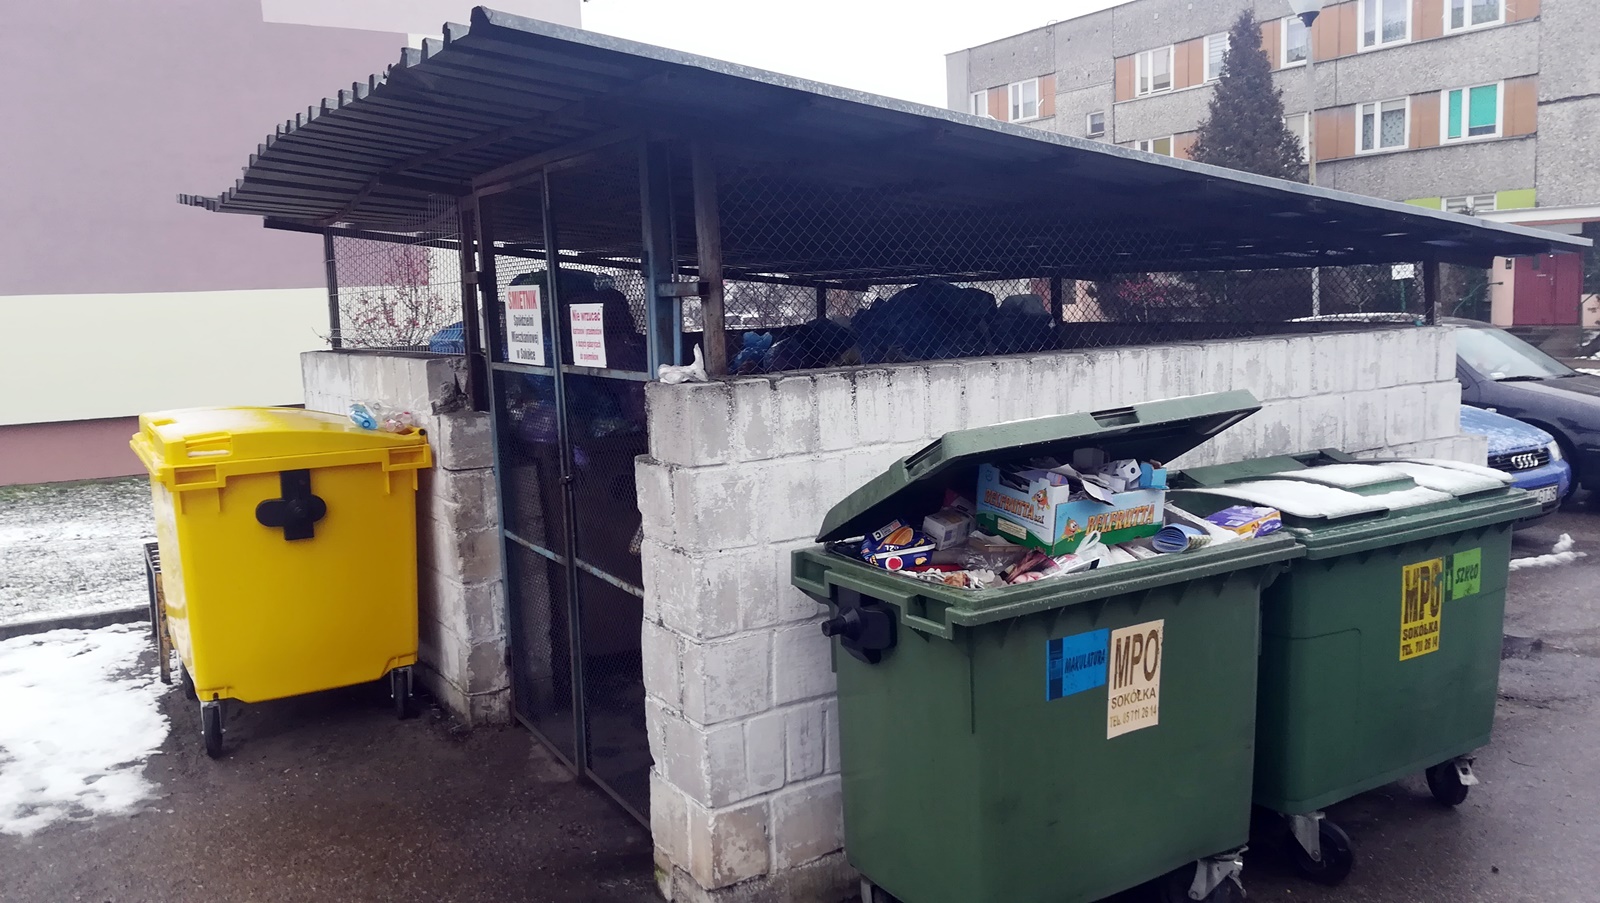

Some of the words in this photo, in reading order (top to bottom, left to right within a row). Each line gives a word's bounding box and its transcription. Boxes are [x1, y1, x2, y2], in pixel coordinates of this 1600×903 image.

[572, 310, 580, 321] Nie
[984, 489, 1034, 520] BELFRUTTA
[1085, 504, 1155, 535] BELFRUTTA
[1404, 563, 1441, 624] MPO
[1402, 620, 1438, 641] SOKÓŁKA
[1064, 648, 1106, 674] MAKULATURA
[1113, 629, 1160, 690] MPO
[1111, 687, 1156, 710] SOKÓŁKA
[1141, 706, 1149, 719] 26
[1150, 704, 1157, 717] 14
